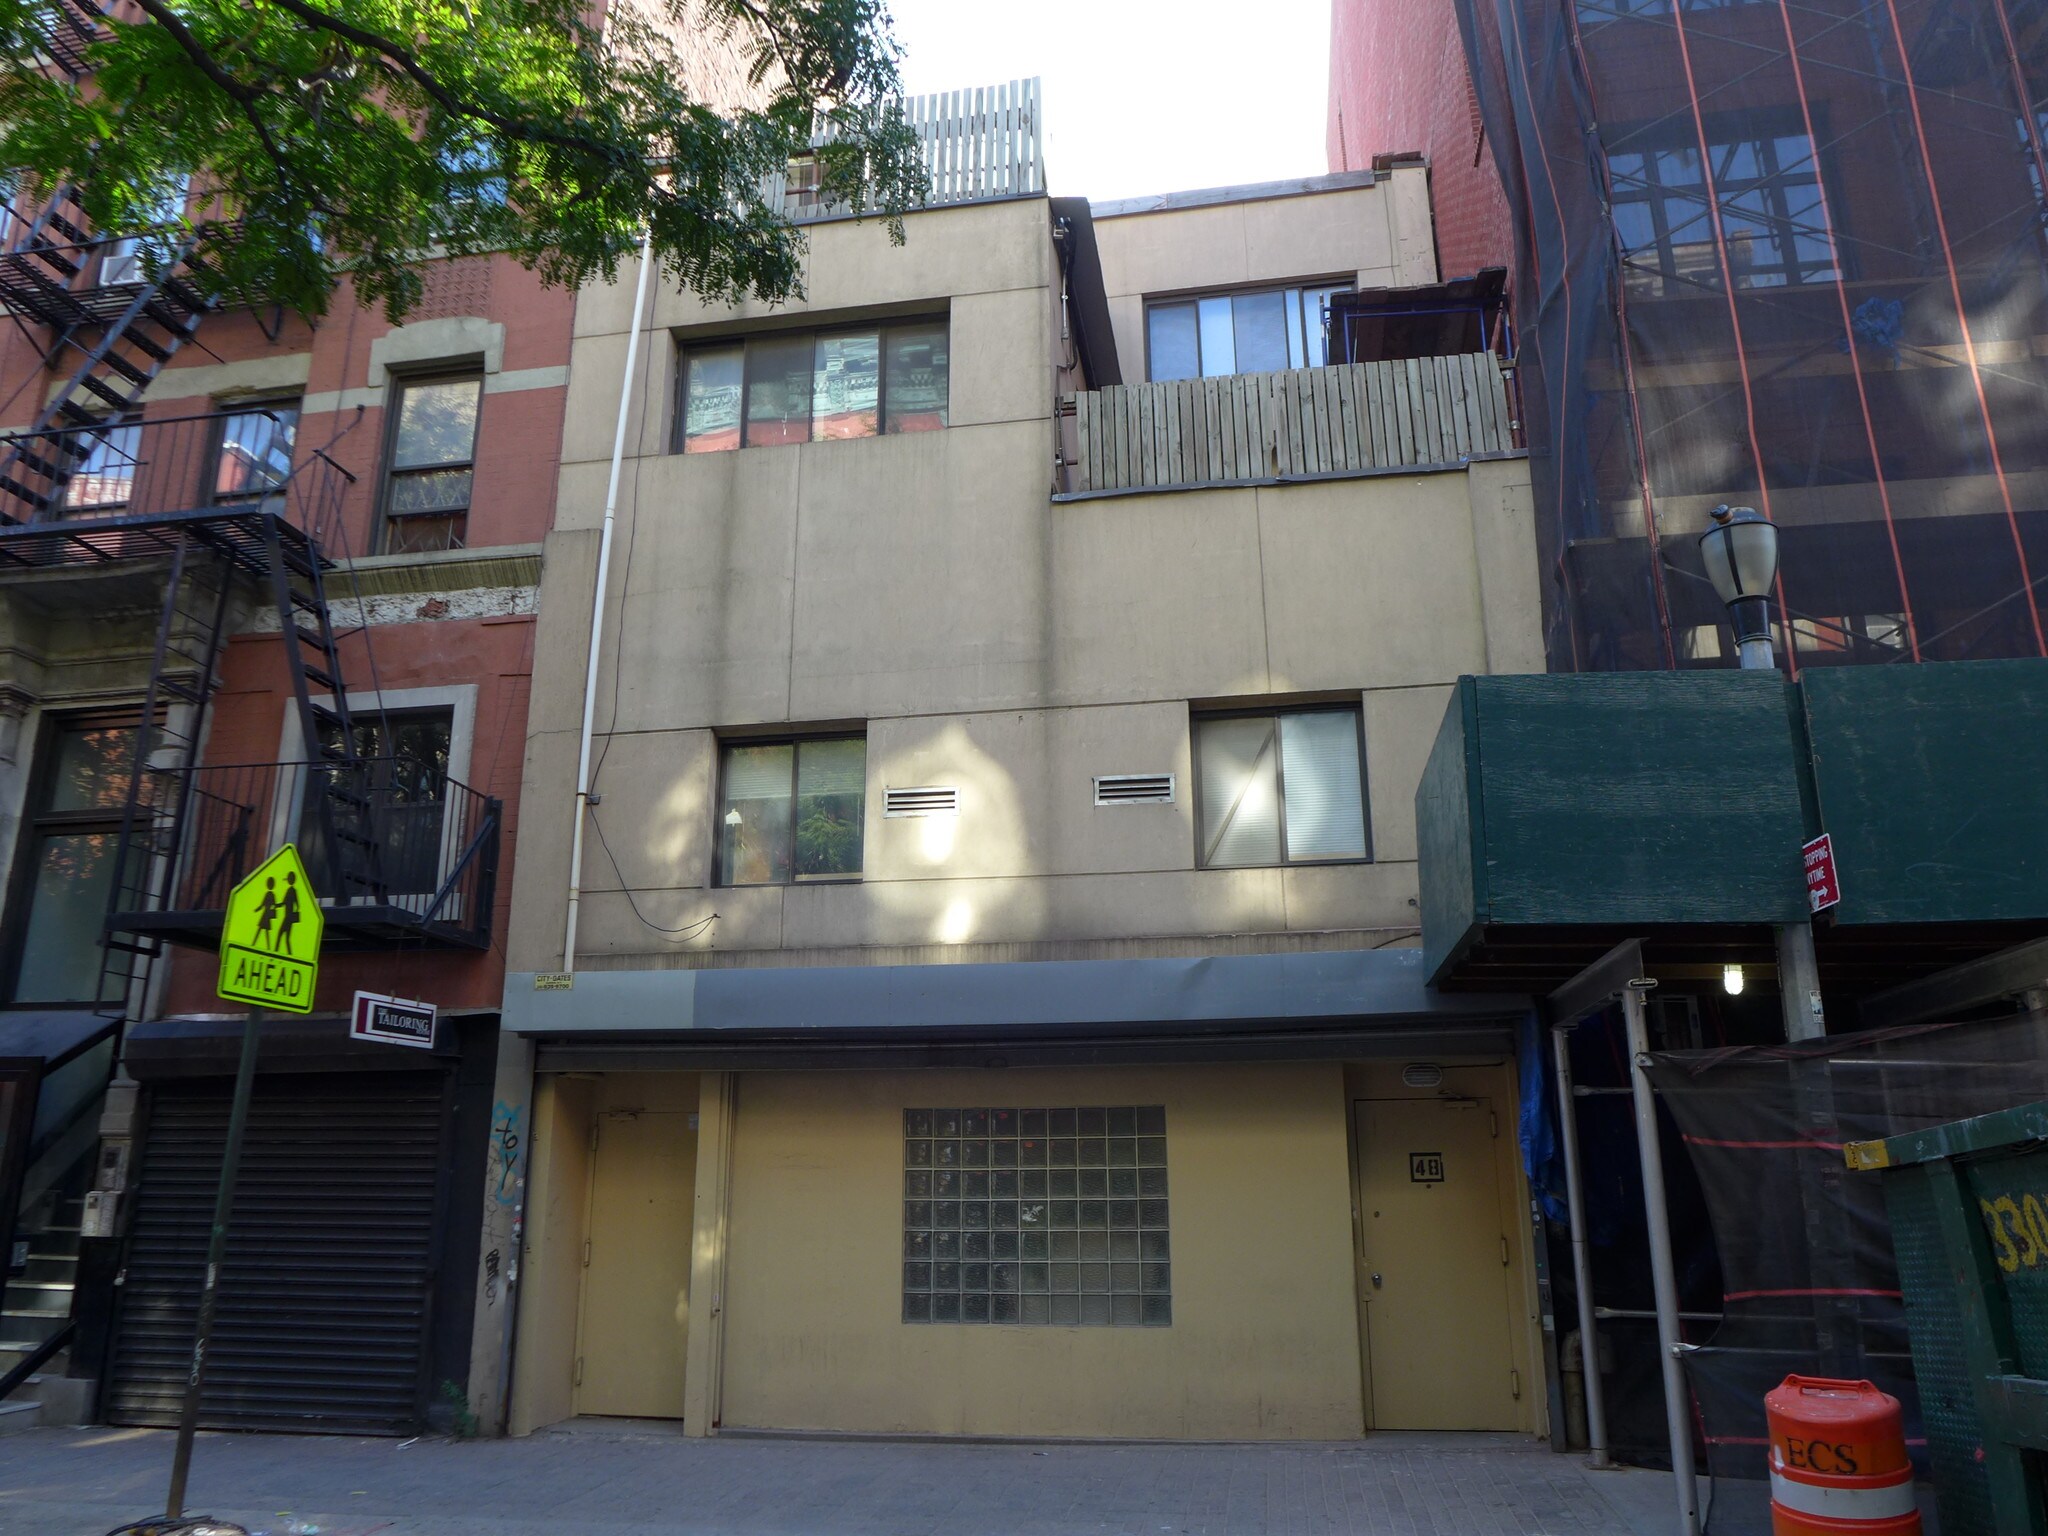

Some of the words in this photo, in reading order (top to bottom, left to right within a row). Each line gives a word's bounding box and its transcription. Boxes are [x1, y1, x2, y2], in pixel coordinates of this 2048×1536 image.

[234, 957, 301, 998] AHEAD
[378, 1013, 429, 1030] TAILORING
[1415, 1159, 1440, 1176] 48
[1786, 1437, 1858, 1475] ECS
